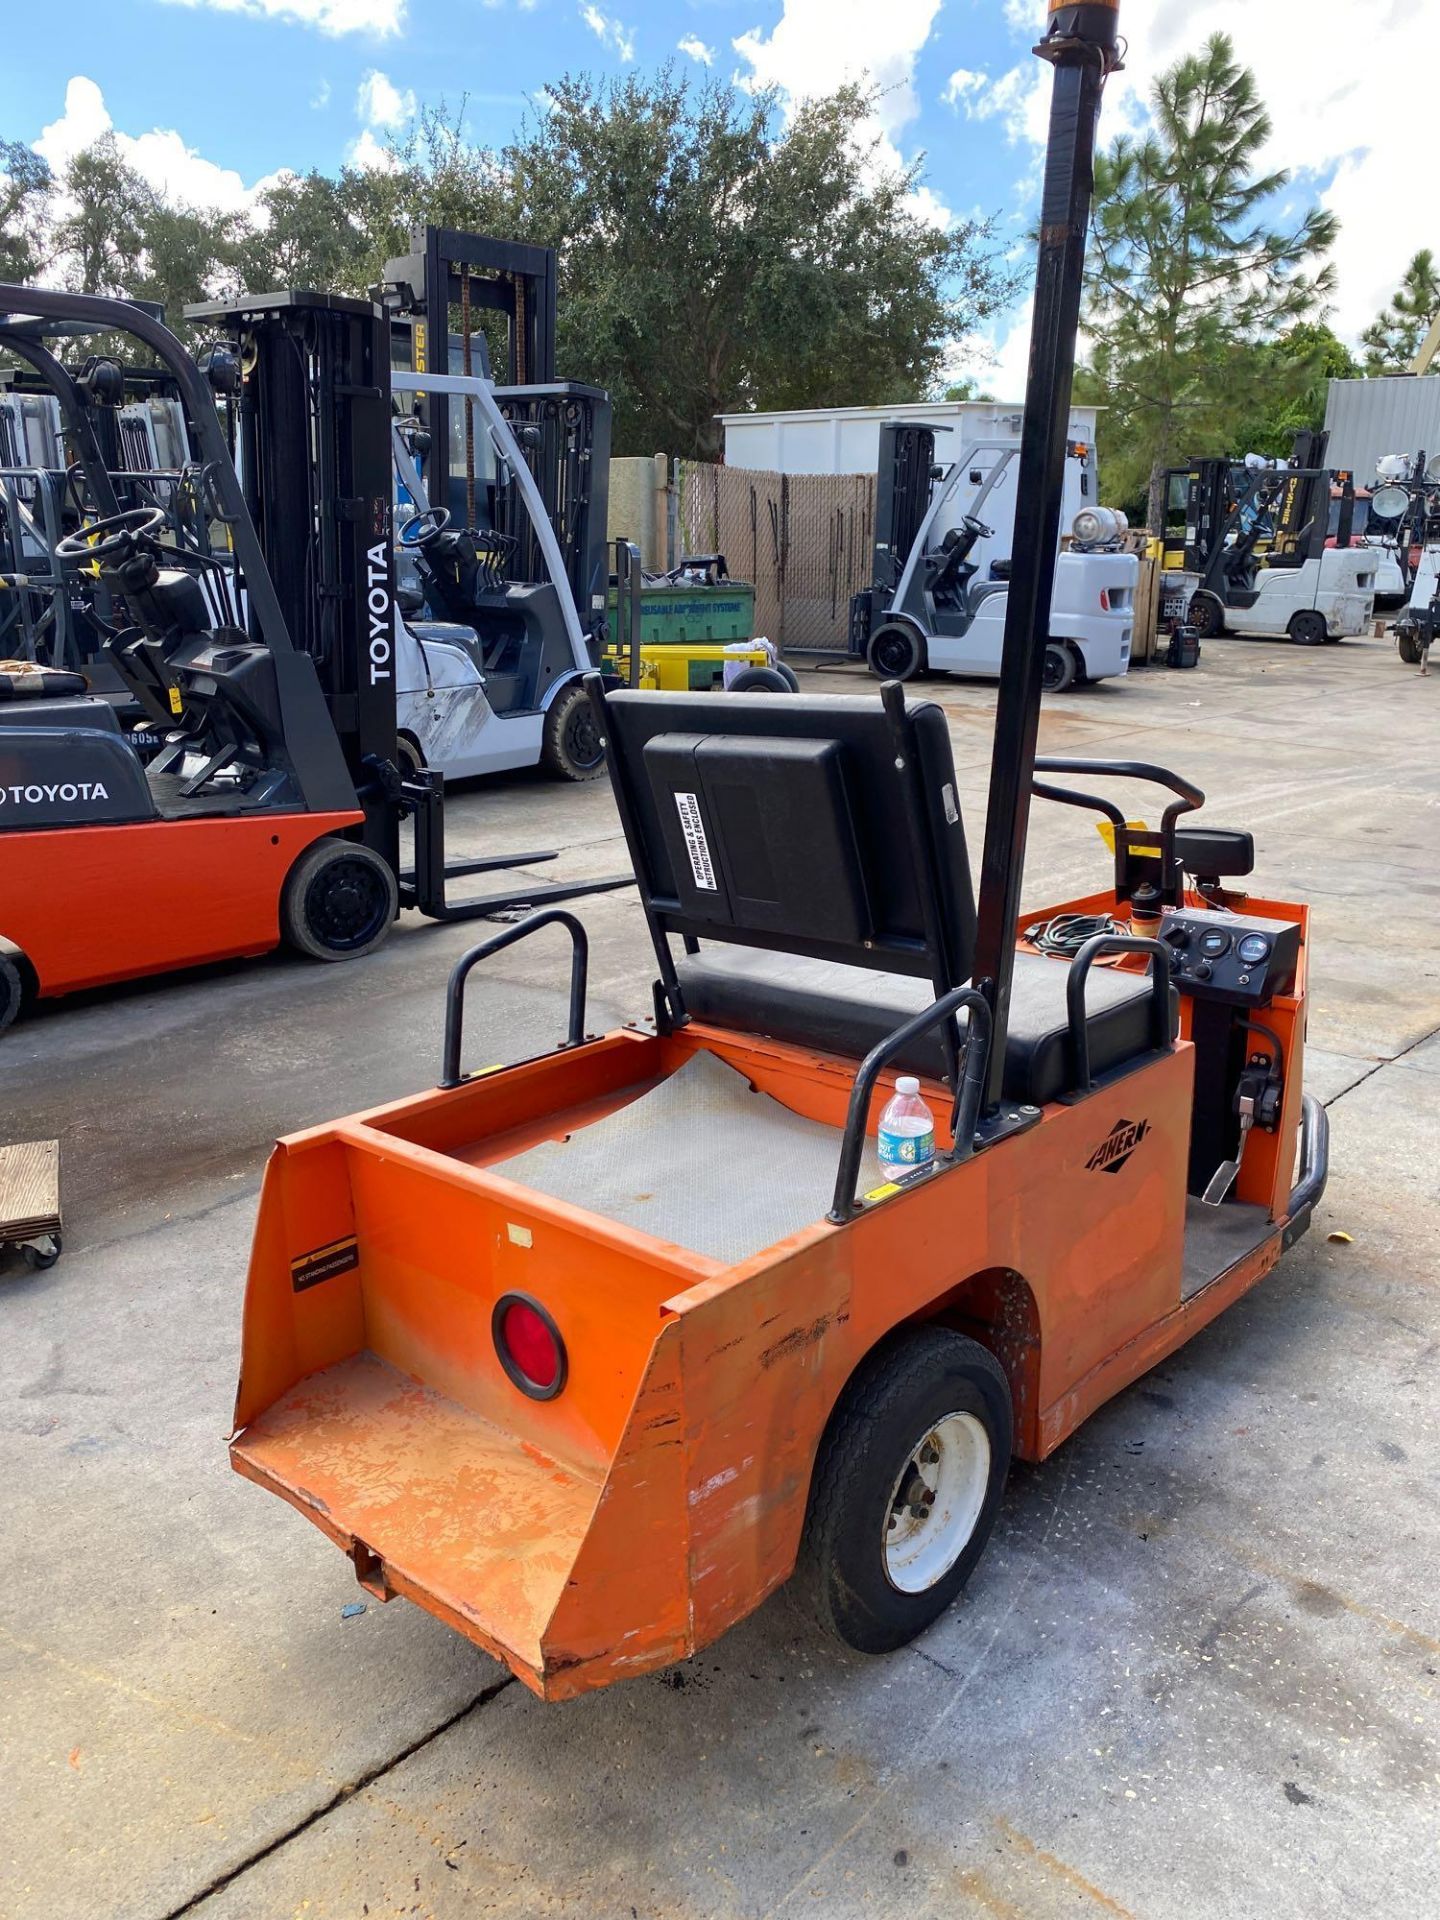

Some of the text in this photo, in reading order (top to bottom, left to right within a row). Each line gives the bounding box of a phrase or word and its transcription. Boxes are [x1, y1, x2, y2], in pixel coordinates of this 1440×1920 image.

[415, 323, 426, 397] STER
[1281, 477, 1298, 525] HYSTER
[367, 541, 390, 686] TOYOTA
[9, 782, 109, 804] TOYOTA
[680, 801, 692, 830] SAFETY
[687, 795, 715, 888] INSTRUCTIONS ENCLOSED
[688, 839, 704, 880] OPERATING
